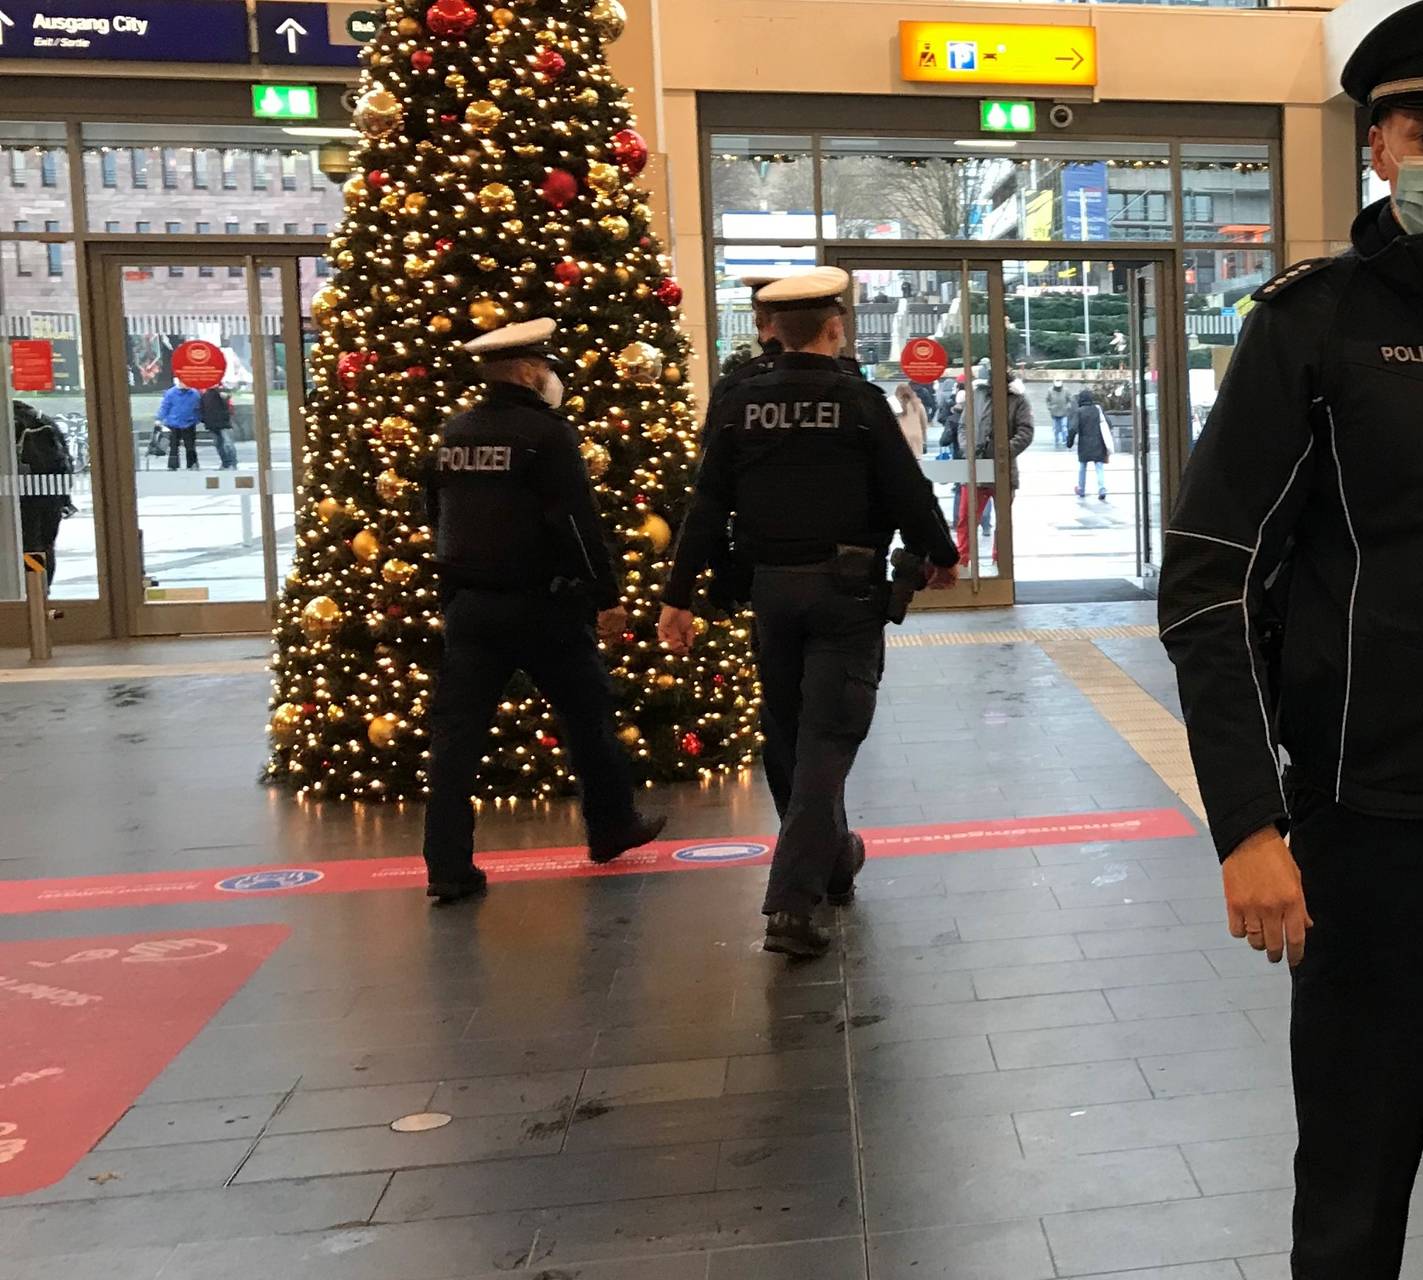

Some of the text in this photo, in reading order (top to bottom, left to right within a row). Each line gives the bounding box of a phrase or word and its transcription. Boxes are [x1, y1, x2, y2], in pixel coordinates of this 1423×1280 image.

[33, 13, 149, 35] Ausgang City
[438, 446, 512, 472] POLIZEI
